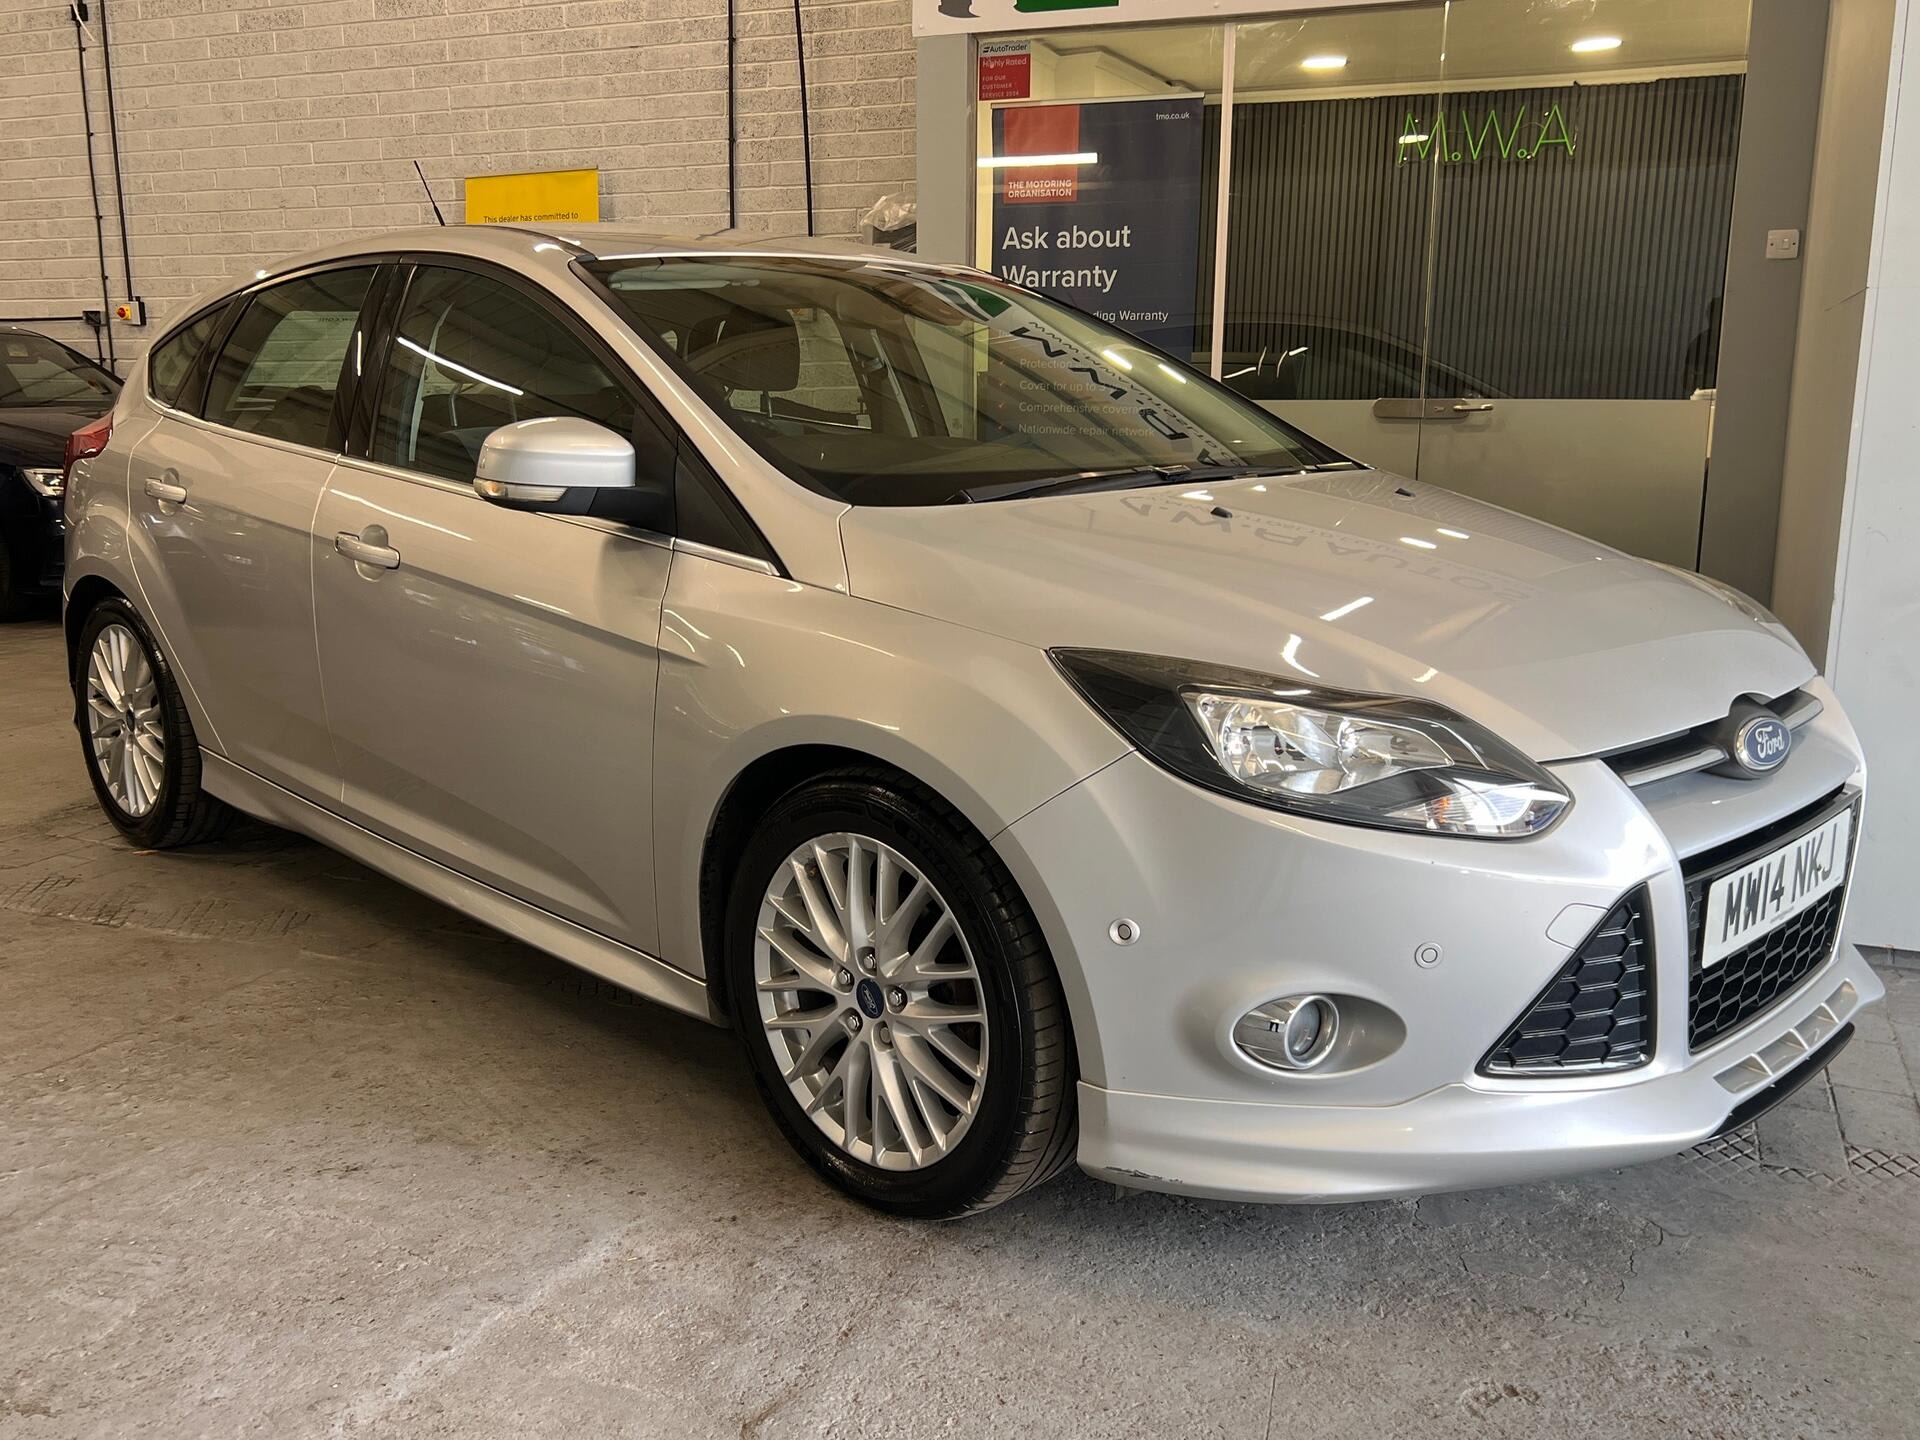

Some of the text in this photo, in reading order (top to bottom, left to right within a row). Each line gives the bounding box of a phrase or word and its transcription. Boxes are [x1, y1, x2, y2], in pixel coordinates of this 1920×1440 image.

[990, 44, 1028, 53] AutoTrader
[1005, 57, 1028, 66] Rated
[1155, 111, 1191, 121] tmo.co.uk
[1398, 103, 1575, 165] M.W.A
[1008, 179, 1073, 190] THE MOTORING
[1008, 188, 1073, 199] ORGANISATION
[483, 211, 579, 224] This dealer has committed to
[1002, 225, 1131, 250] Ask about
[1002, 265, 1118, 293] Warranty
[1119, 310, 1169, 323] Warranty
[1020, 358, 1072, 369] Protection
[1019, 380, 1050, 391] Cover
[1052, 380, 1068, 391] for
[1069, 382, 1083, 393] up
[1085, 381, 1096, 391] to
[1018, 402, 1100, 416] Comprehensive
[1018, 423, 1156, 437] Nationwide repair network
[1754, 724, 1786, 758] Ford
[1721, 822, 1839, 943] MW14 NKJ
